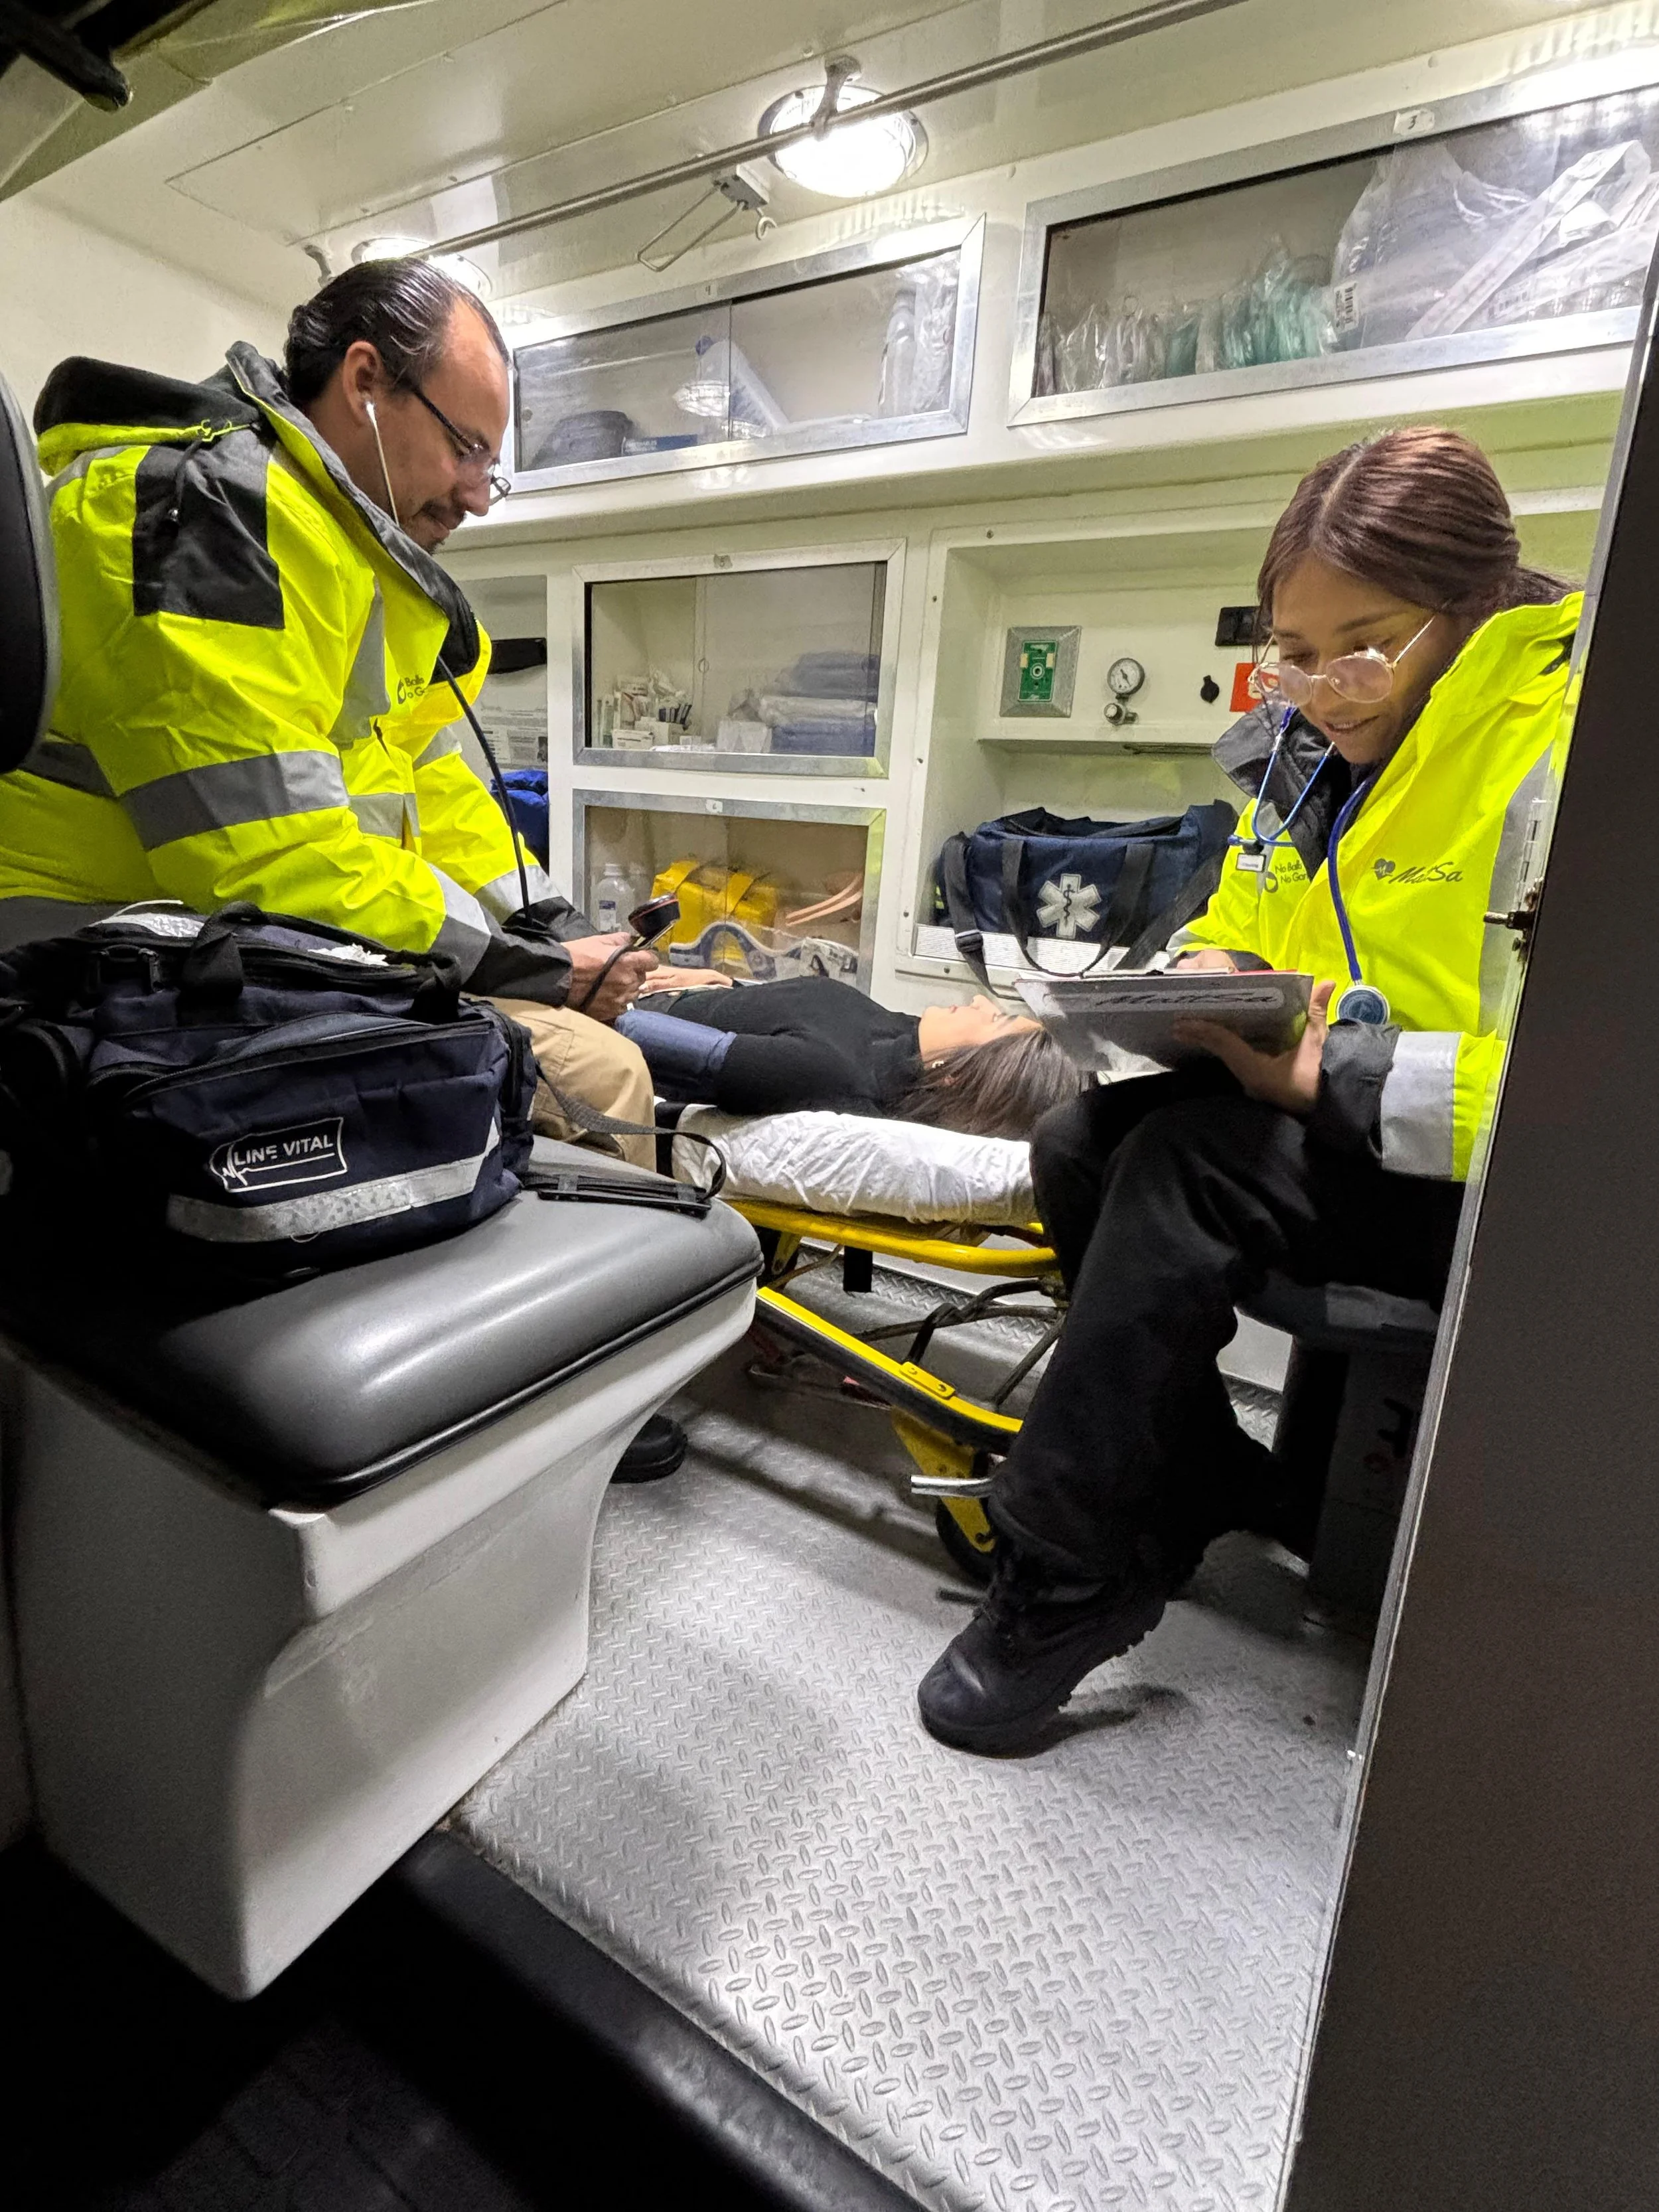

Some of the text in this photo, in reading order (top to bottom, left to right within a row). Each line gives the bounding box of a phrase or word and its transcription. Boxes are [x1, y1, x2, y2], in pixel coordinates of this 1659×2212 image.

[1407, 115, 1417, 129] 3
[1274, 863, 1287, 875] No
[1280, 874, 1291, 884] No
[234, 1134, 334, 1166] LINE VITAL
